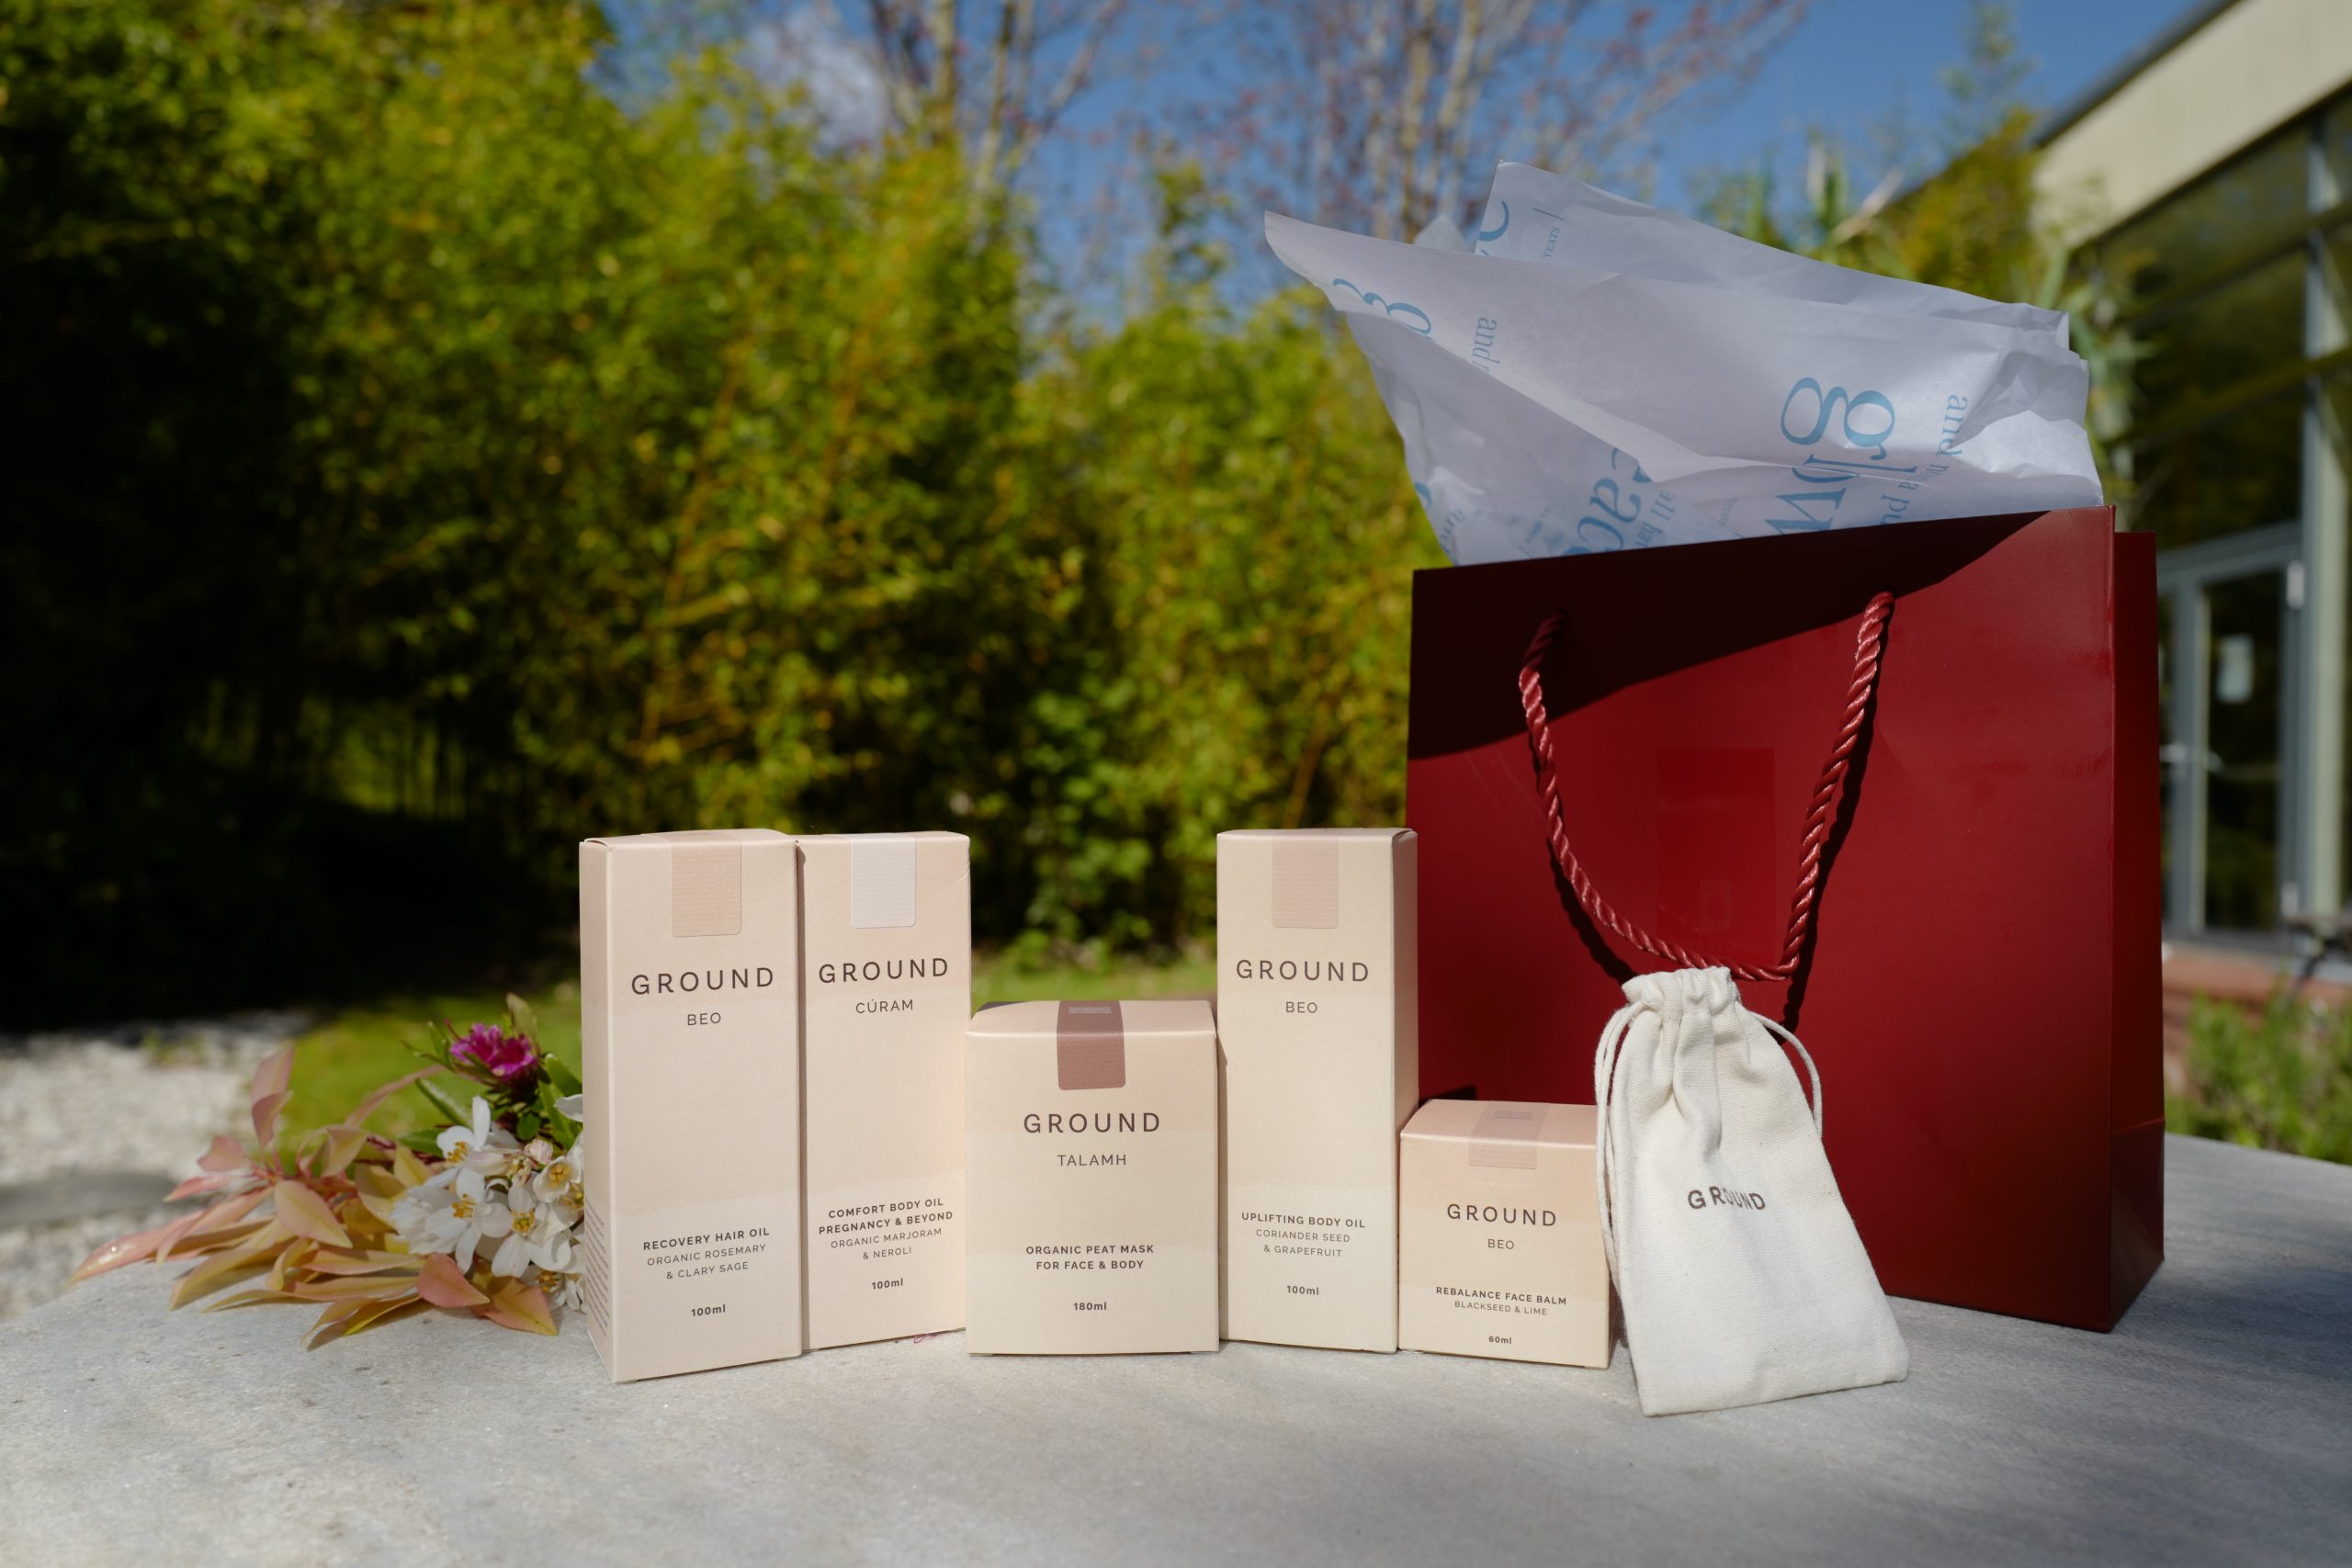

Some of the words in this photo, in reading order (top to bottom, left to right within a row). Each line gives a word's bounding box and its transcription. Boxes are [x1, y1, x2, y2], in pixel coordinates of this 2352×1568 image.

[1542, 225, 1561, 259] YEATS
[1472, 317, 1500, 364] and
[1936, 394, 1968, 457] and
[818, 957, 948, 984] GROUND
[1236, 959, 1369, 983] GROUND
[630, 966, 774, 996] GROUND
[855, 998, 913, 1014] CÚRAM
[1285, 1000, 1318, 1014] BEO
[686, 1011, 722, 1027] BEO
[1023, 1111, 1160, 1134] GROUND
[1056, 1154, 1126, 1168] TALAMH
[1687, 1185, 1767, 1211] GROUND
[828, 1203, 887, 1219] COMFORT
[889, 1200, 922, 1213] BODY
[924, 1197, 944, 1208] OIL
[1446, 1202, 1556, 1227] GROUND
[819, 1218, 891, 1235] PREGNANCY
[894, 1217, 903, 1226] &
[906, 1211, 954, 1225] BEYOND
[1241, 1212, 1305, 1225] UPLIFTING
[1308, 1216, 1341, 1227] BODY
[1344, 1218, 1366, 1228] OIL
[642, 1234, 711, 1251] RECOVERY
[715, 1230, 745, 1243] HAIR
[749, 1226, 770, 1238] OIL
[830, 1235, 880, 1249] ORGANIC
[883, 1227, 942, 1243] MARJORAM
[1255, 1228, 1318, 1241] CORIANDER
[1322, 1233, 1351, 1243] SEED
[1025, 1245, 1081, 1255] ORGANIC
[1086, 1245, 1116, 1255] PEAT
[1120, 1244, 1155, 1254] MASK
[1263, 1244, 1271, 1253] &
[1273, 1245, 1342, 1258] GRAPEFRUIT
[1487, 1238, 1515, 1250] BEO
[647, 1251, 701, 1267] ORGANIC
[705, 1243, 766, 1259] ROSEMARY
[862, 1251, 869, 1260] &
[873, 1246, 912, 1259] NEROLI
[666, 1270, 674, 1280] &
[677, 1265, 716, 1279] CLARY
[718, 1260, 749, 1273] SAGE
[1035, 1260, 1060, 1270] FOR
[1064, 1260, 1095, 1270] FACE
[1098, 1260, 1107, 1269] &
[1111, 1259, 1144, 1269] BODY
[871, 1277, 904, 1291] 100ml
[1285, 1285, 1319, 1296] 100ml
[1435, 1286, 1501, 1300] REBALANCE
[1505, 1292, 1532, 1303] FACE
[1536, 1294, 1566, 1306] BALM
[690, 1303, 726, 1317] 100ml
[1072, 1301, 1107, 1312] 180ml
[1454, 1300, 1511, 1313] BLACKSEED
[1514, 1305, 1521, 1314] &
[1523, 1306, 1547, 1316] LIME
[1487, 1335, 1512, 1345] 60ml
